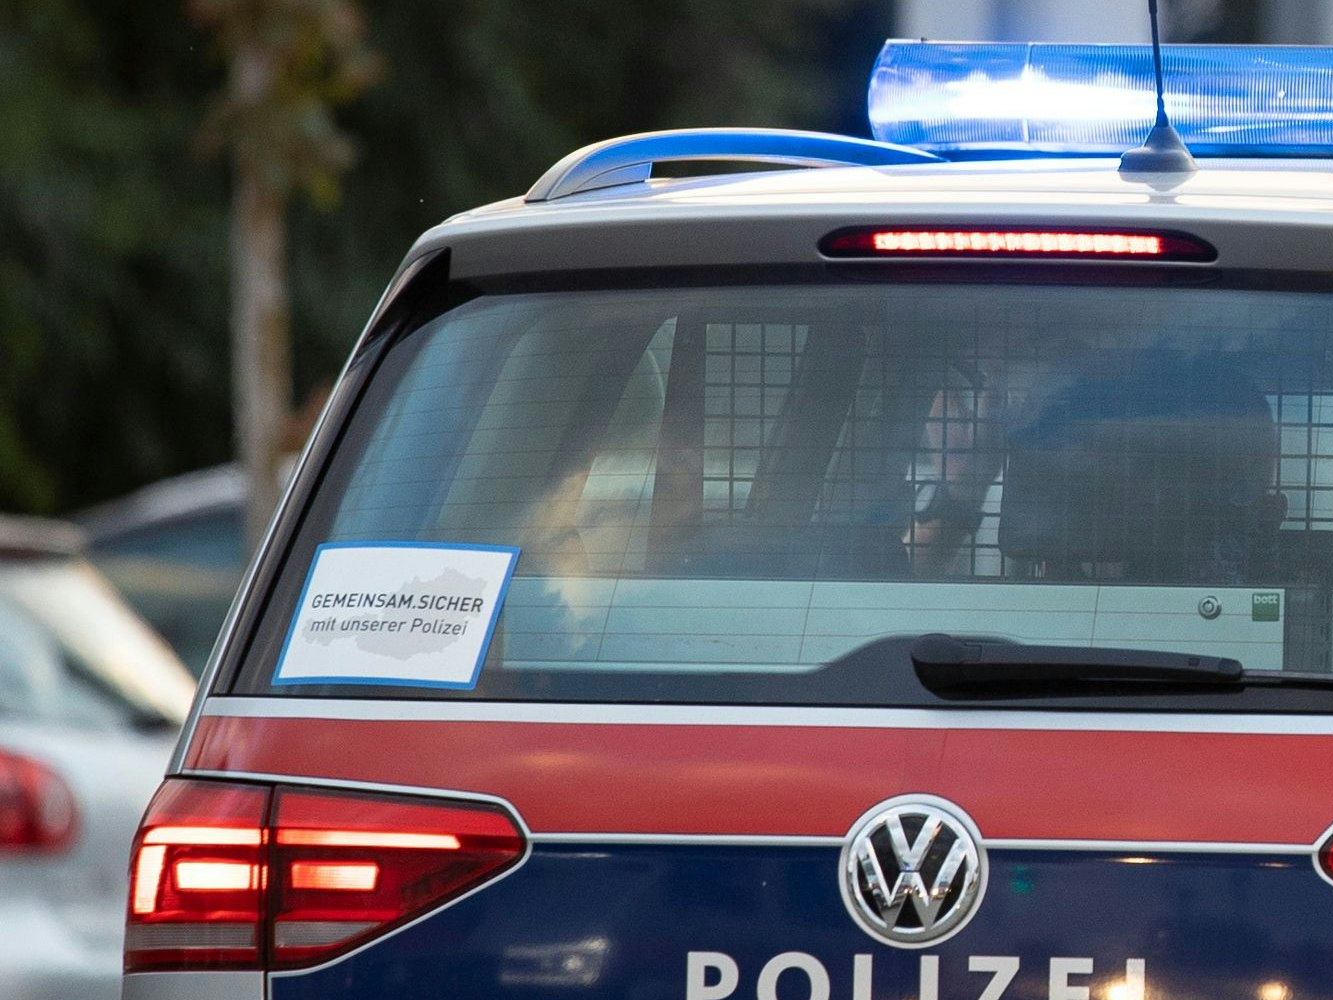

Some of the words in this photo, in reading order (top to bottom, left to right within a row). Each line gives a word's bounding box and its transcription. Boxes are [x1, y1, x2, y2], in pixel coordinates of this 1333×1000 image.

[311, 593, 484, 612] GEMEINSAM.SICHER
[310, 616, 336, 632] mit
[341, 618, 407, 633] unserer
[409, 618, 468, 636] Polizei
